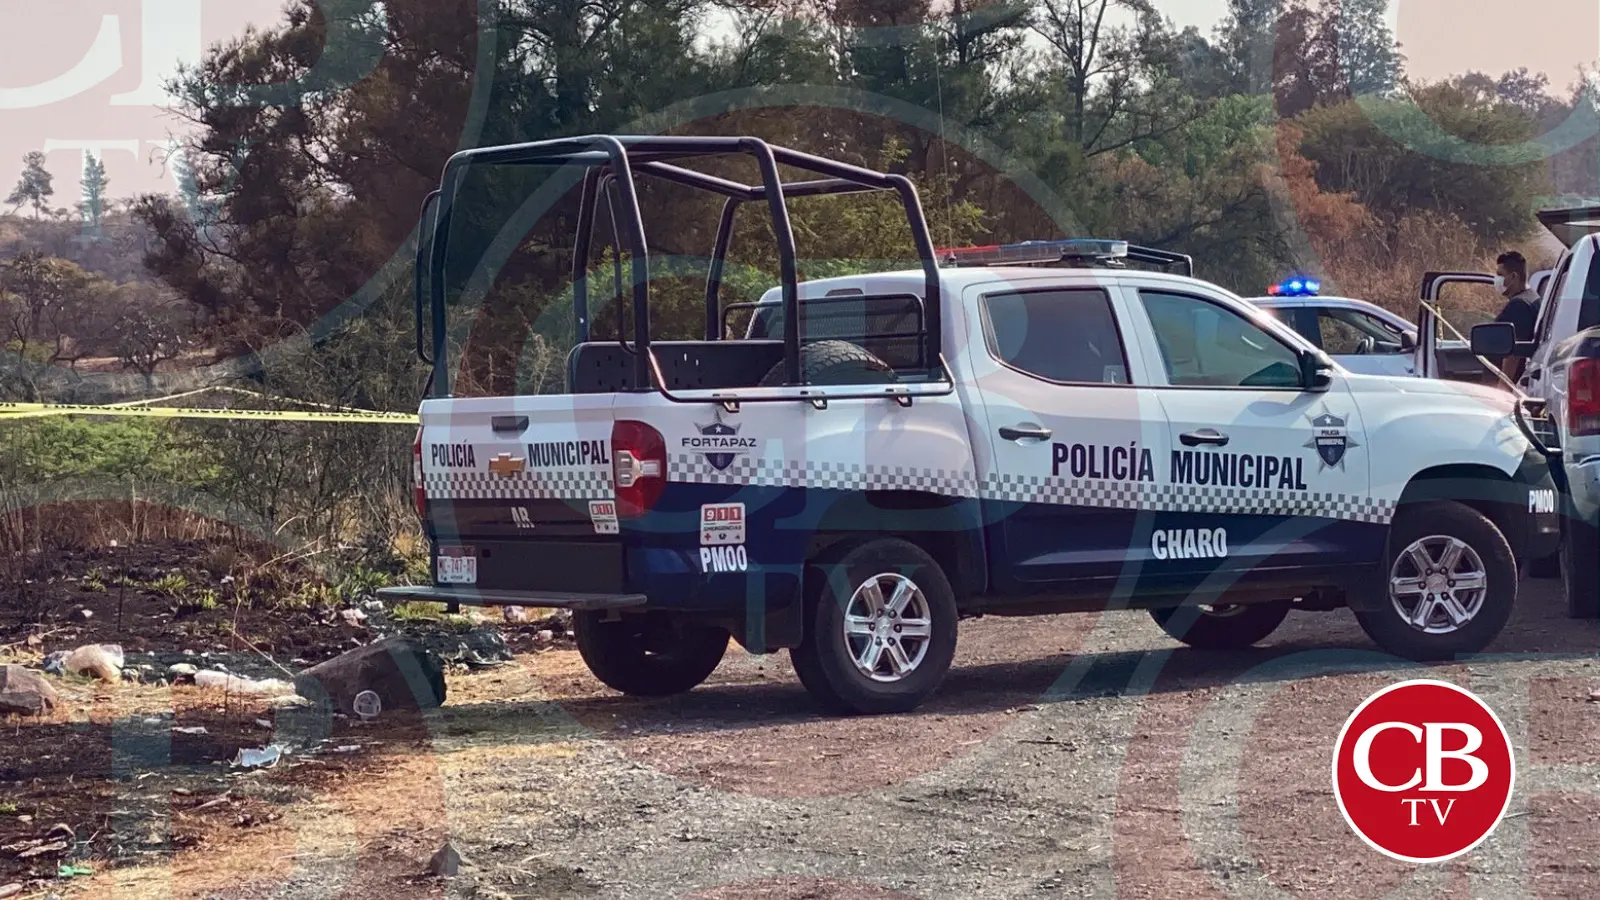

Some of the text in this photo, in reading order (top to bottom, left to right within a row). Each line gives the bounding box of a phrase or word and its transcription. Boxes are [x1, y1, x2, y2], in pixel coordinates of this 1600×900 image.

[431, 439, 610, 468] POLICÍA MUNICIPAL
[681, 437, 757, 447] FORTAPAZ
[1052, 441, 1307, 490] POLICÍA MUNICIPAL
[706, 508, 739, 520] 911
[1152, 527, 1228, 560] CHARO
